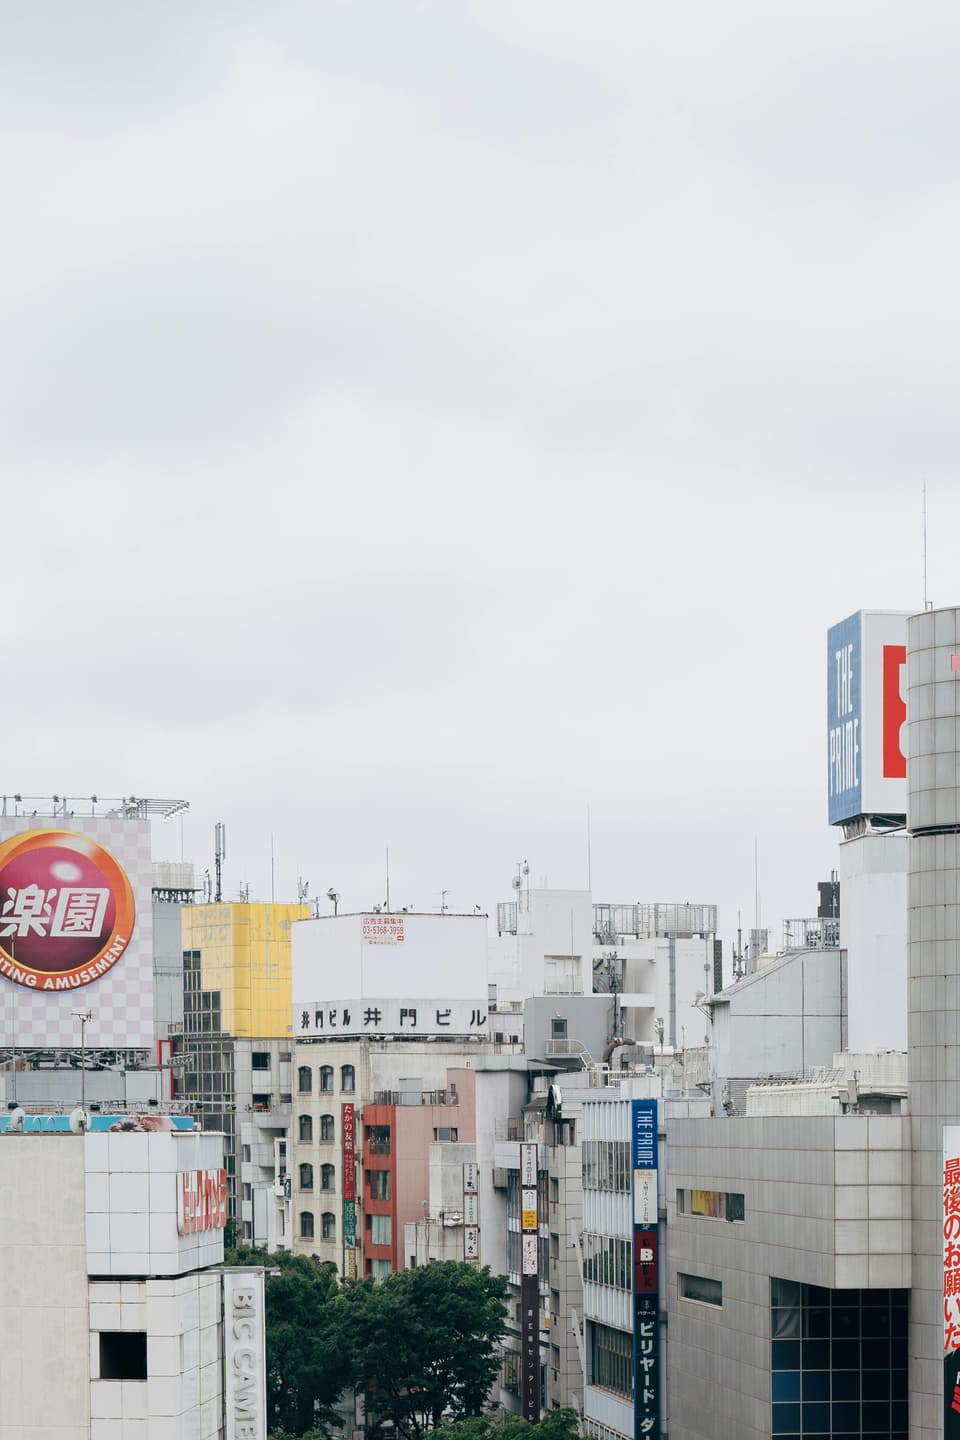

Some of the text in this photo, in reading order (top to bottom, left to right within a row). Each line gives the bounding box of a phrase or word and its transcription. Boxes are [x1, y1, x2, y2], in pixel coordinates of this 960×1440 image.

[835, 643, 853, 719] THE
[829, 717, 860, 798] PRIME
[0, 884, 110, 937] 楽園
[43, 934, 128, 990] AMUSEMENT
[301, 1009, 351, 1028] 井門ビル
[363, 1008, 487, 1027] 井門ビル
[636, 1109, 653, 1129] THE
[636, 1132, 653, 1166] PRIME
[232, 1287, 257, 1342] BIC
